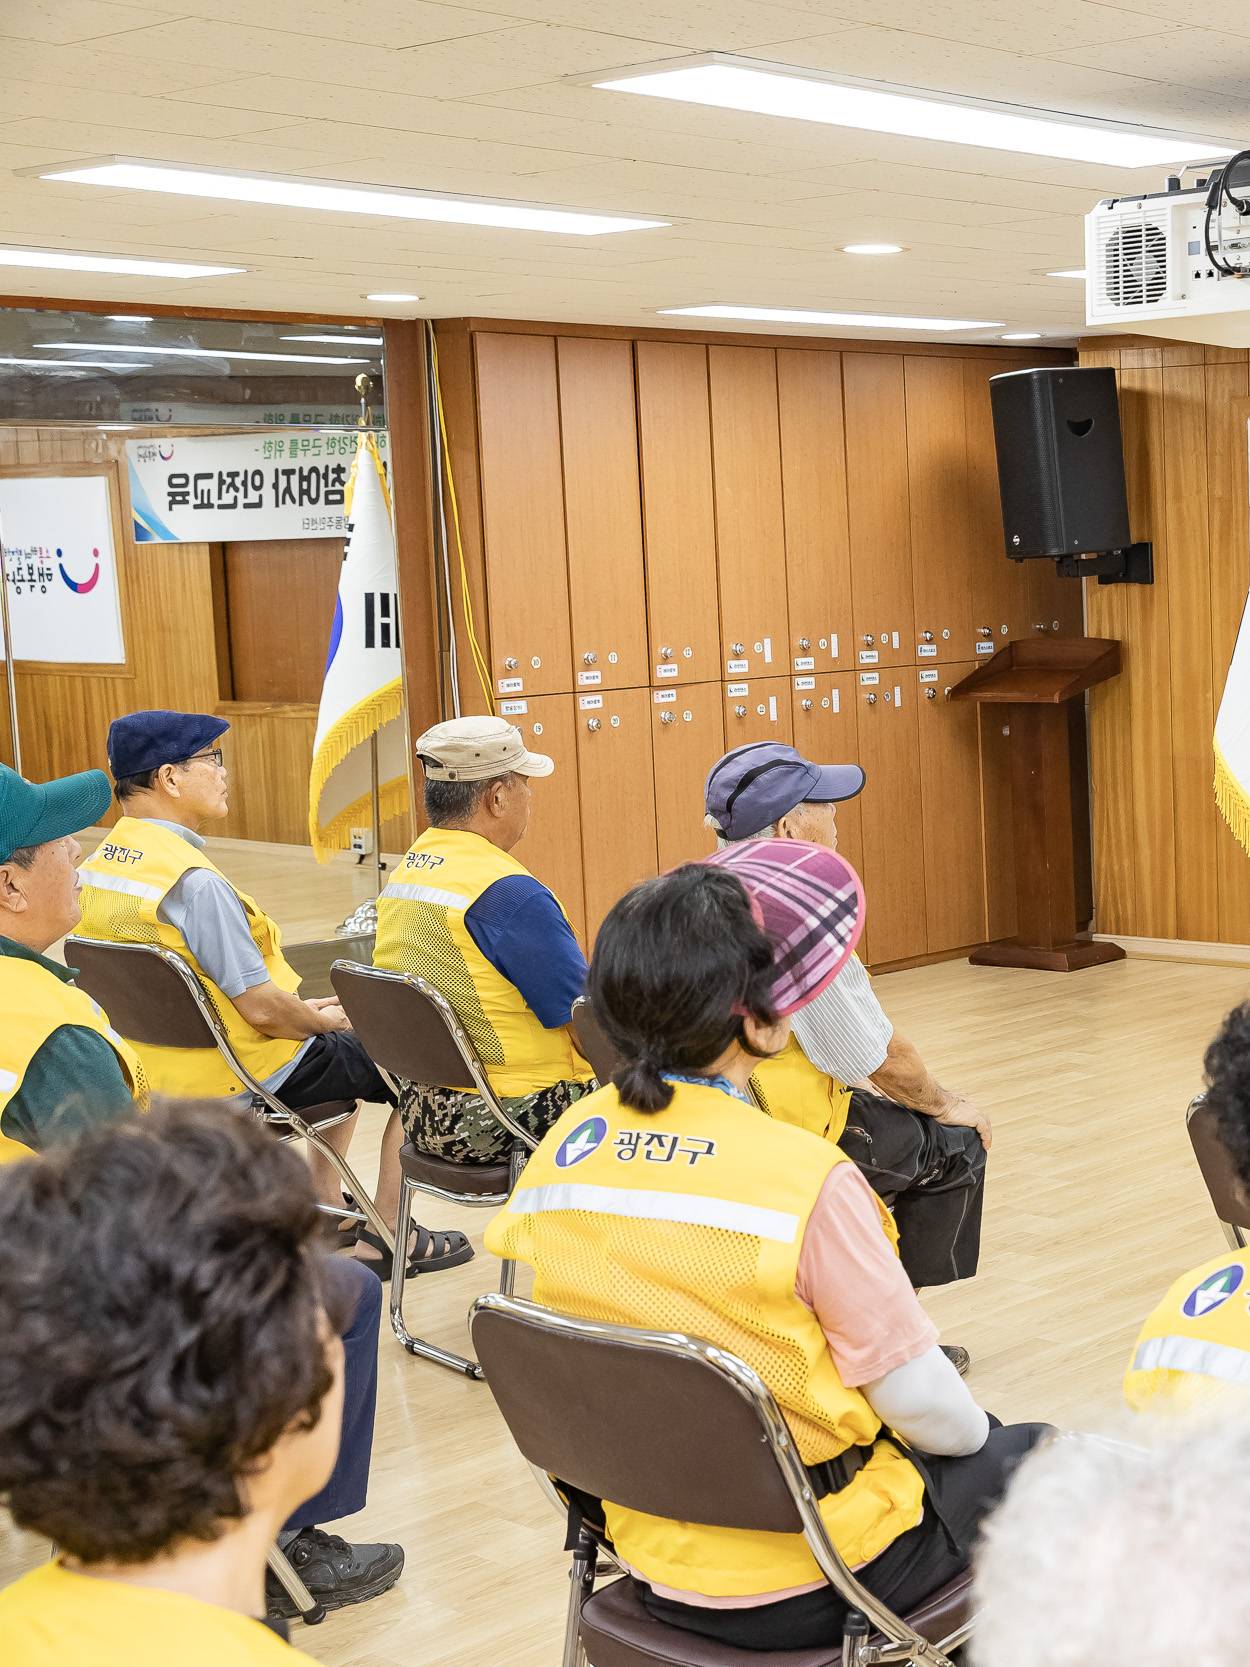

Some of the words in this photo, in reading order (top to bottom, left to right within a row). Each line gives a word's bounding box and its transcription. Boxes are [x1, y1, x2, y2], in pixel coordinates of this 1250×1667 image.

[102, 842, 144, 865] 광진구
[405, 851, 445, 870] 광진구
[613, 1131, 716, 1165] 광진구
